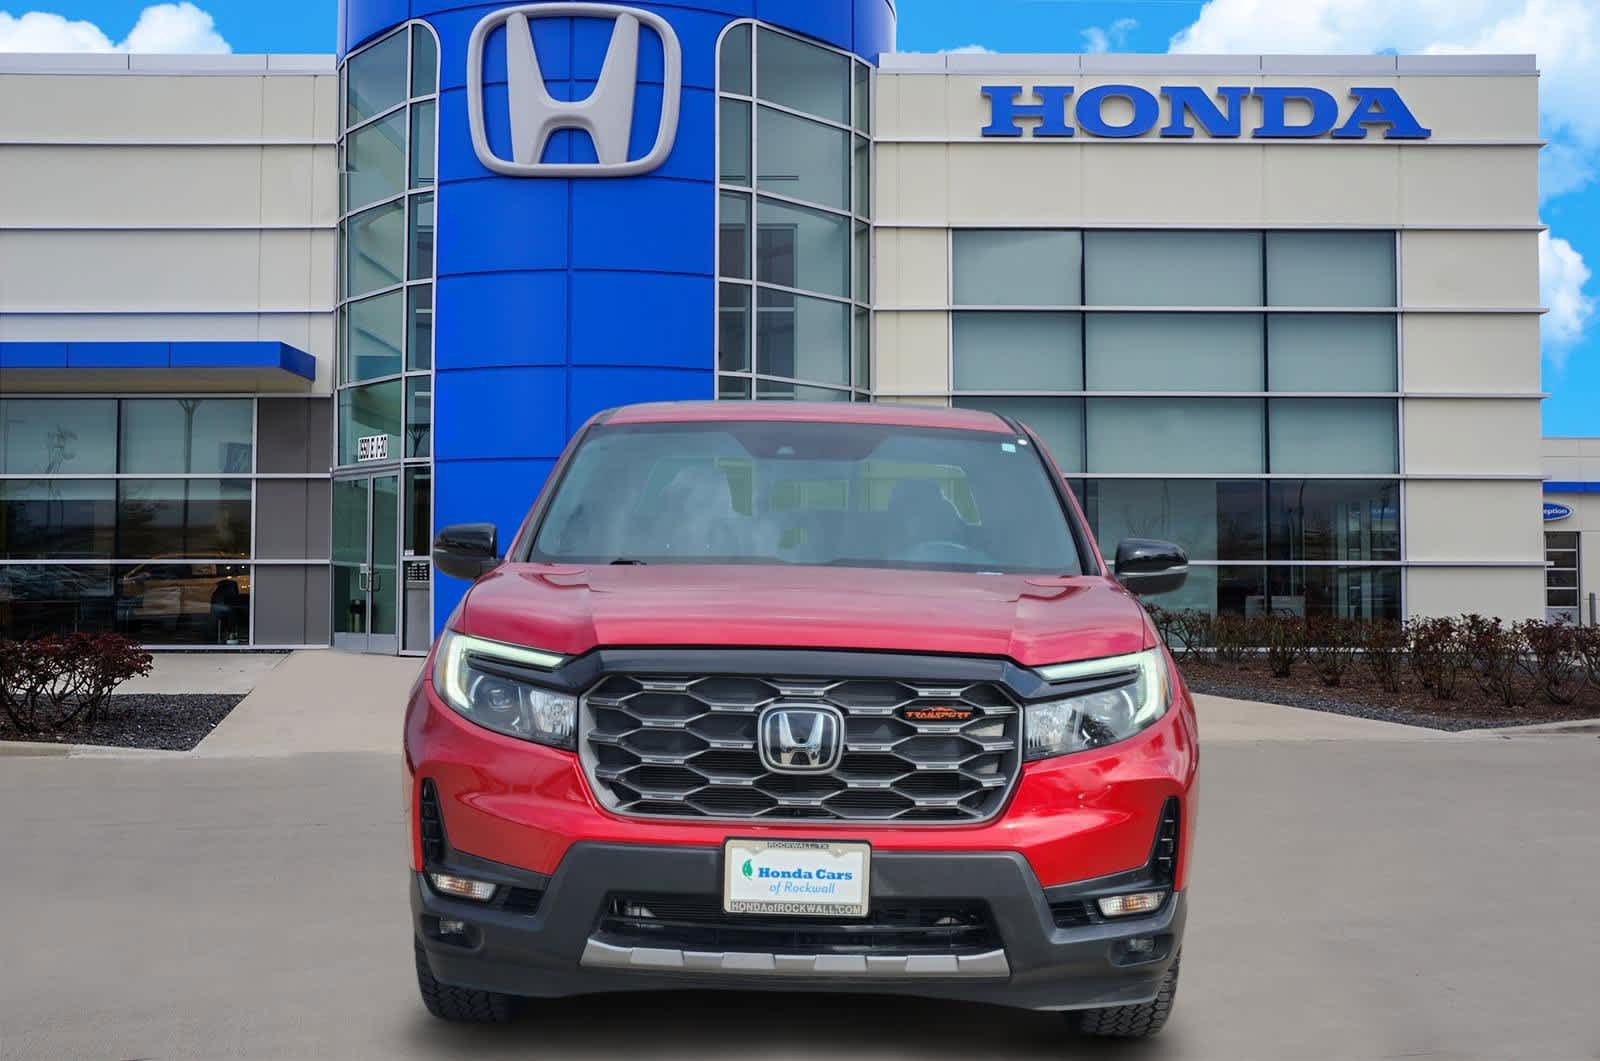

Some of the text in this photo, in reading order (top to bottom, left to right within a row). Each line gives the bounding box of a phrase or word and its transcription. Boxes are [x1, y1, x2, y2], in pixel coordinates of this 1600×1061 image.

[980, 84, 1432, 139] HONDA
[1543, 507, 1568, 516] eption
[758, 867, 853, 881] Honda Cars
[769, 881, 836, 895] of Rockwall
